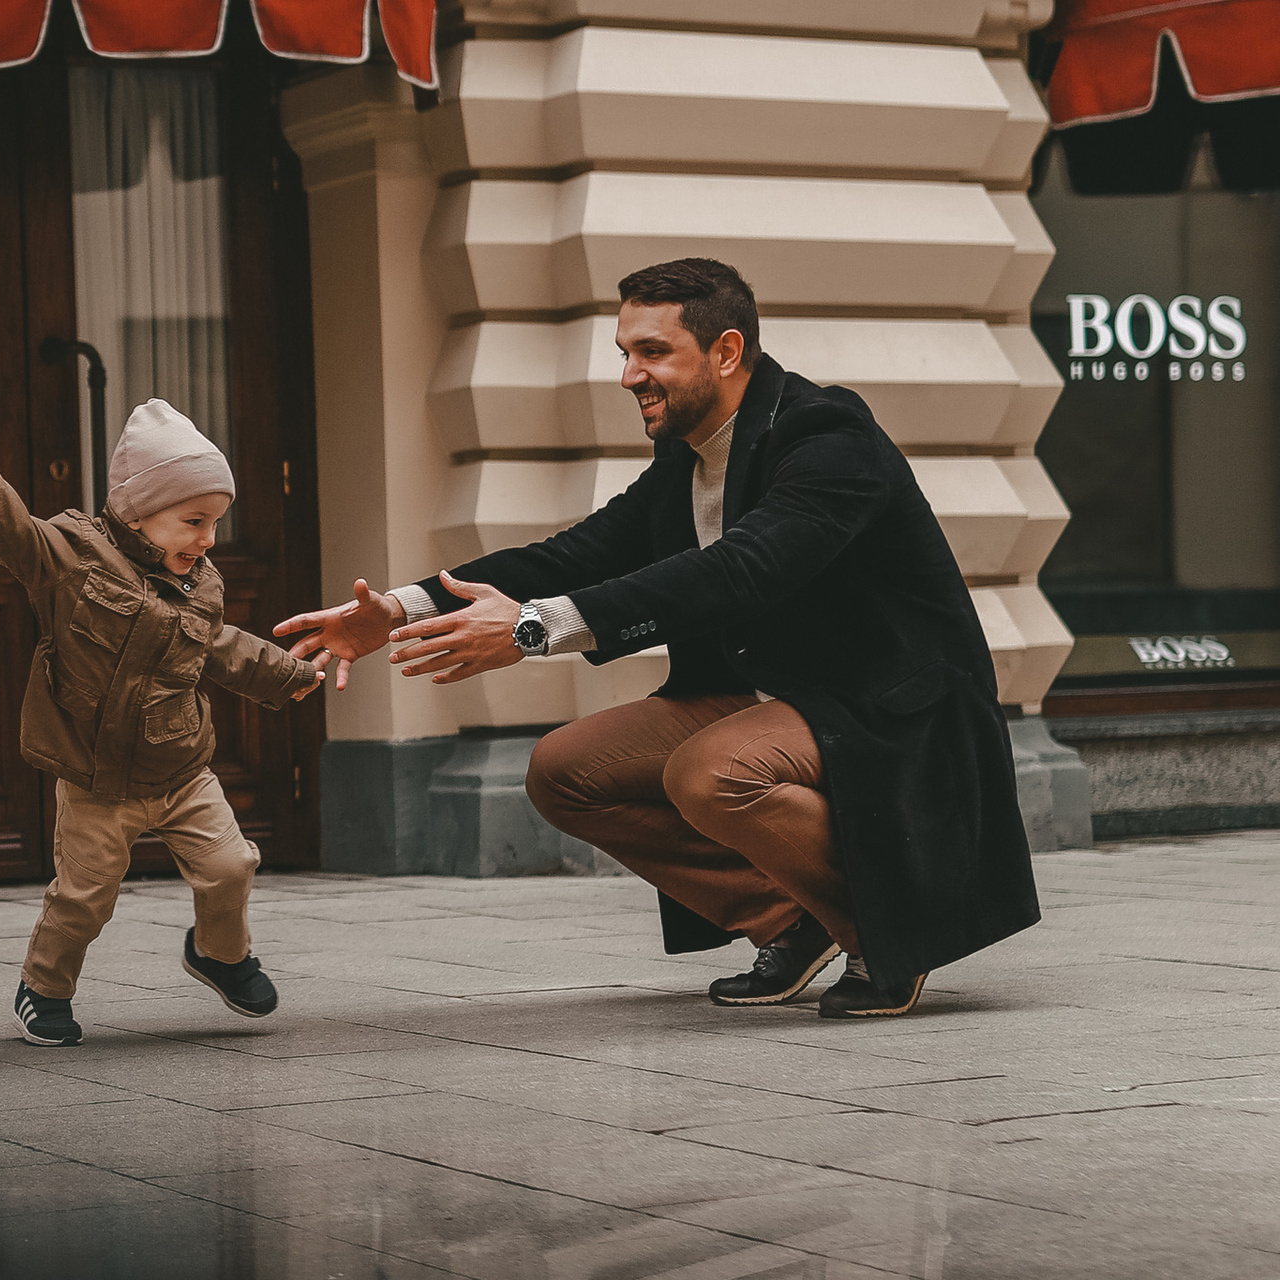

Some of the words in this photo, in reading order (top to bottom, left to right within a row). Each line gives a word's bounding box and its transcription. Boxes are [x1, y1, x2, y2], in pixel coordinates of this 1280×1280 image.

[1066, 293, 1247, 359] BOSS
[1070, 361, 1150, 381] HUGO
[1169, 361, 1246, 381] BOSS
[1128, 635, 1230, 663] BOSS
